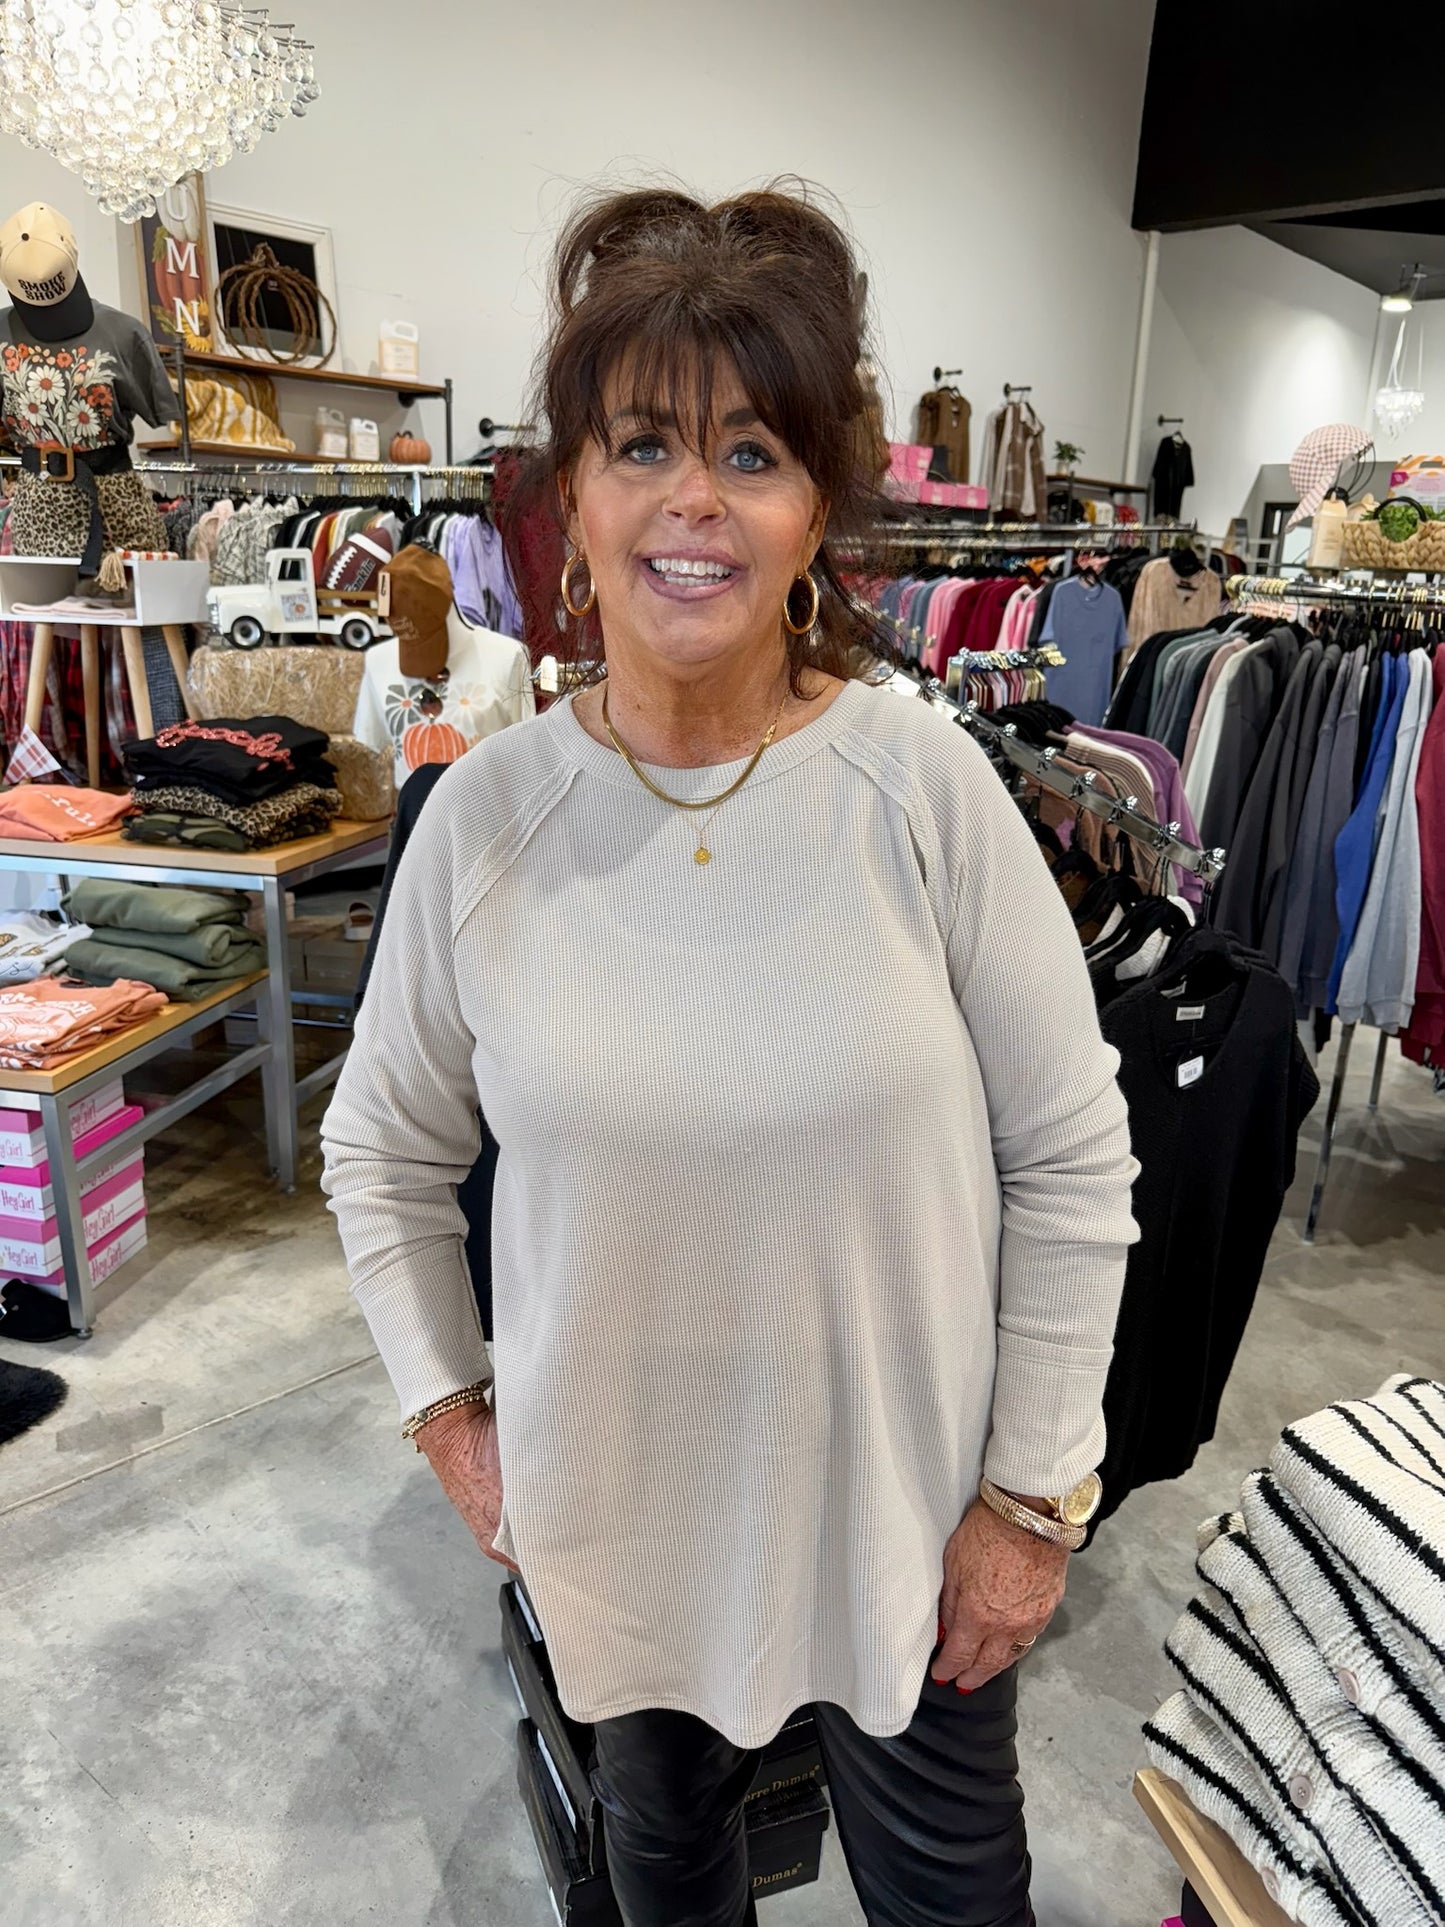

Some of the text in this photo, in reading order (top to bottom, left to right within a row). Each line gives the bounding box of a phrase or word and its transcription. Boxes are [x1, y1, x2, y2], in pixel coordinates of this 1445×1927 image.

[18, 271, 65, 292] SMOKE
[25, 282, 66, 301] SHOW
[743, 1786, 770, 1803] erre
